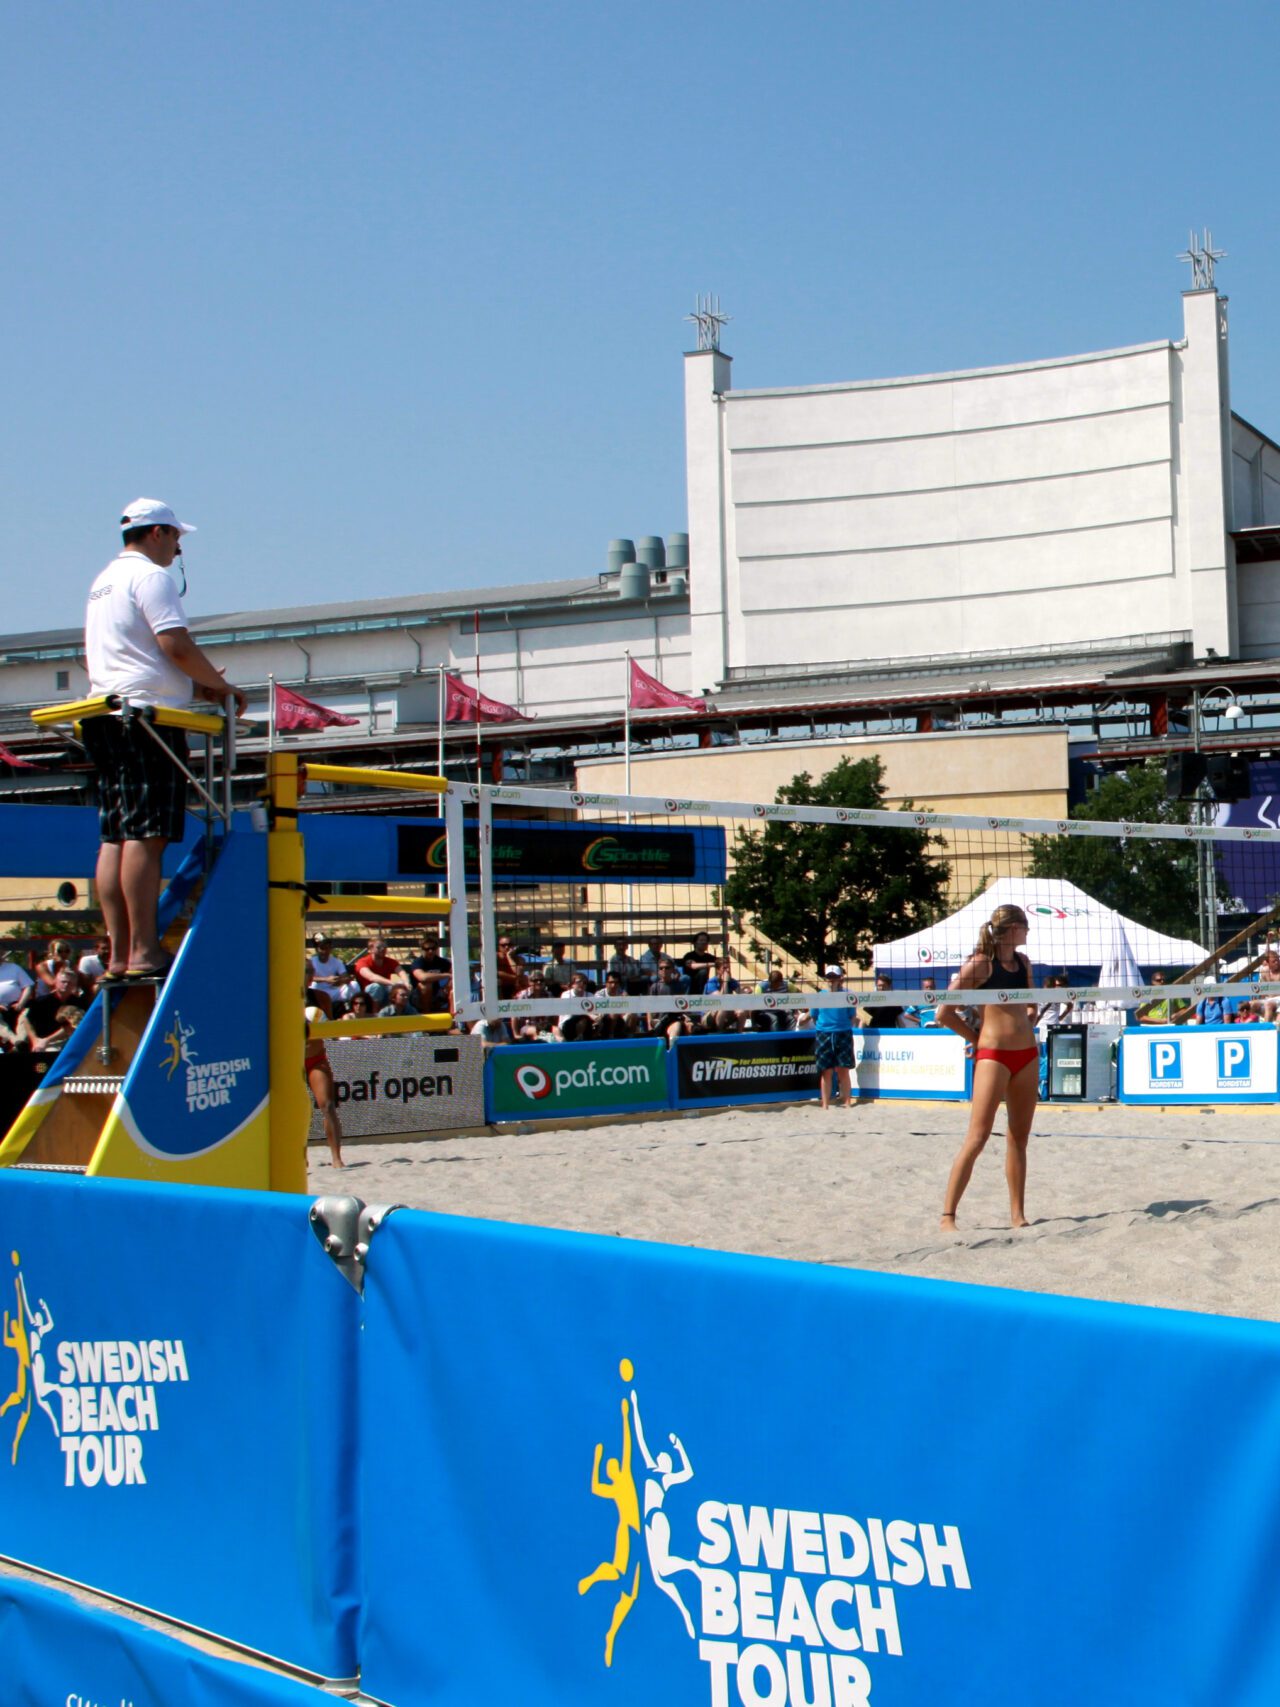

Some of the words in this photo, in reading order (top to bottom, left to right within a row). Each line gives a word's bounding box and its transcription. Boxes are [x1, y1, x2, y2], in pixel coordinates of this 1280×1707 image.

[584, 795, 620, 806] paf.com
[677, 801, 711, 812] paf.com
[765, 805, 797, 816] paf.com
[847, 811, 876, 821] paf.com
[595, 999, 630, 1010] paf.com
[689, 998, 721, 1008] paf.com
[776, 996, 807, 1006] paf.com
[186, 1057, 252, 1081] SWEDISH
[691, 1060, 818, 1083] GYMGROSSISTEN.com
[791, 1055, 817, 1063] Athlete
[857, 1050, 883, 1061] GAMLA
[885, 1050, 914, 1061] ULLEVI
[1156, 1043, 1176, 1078] P
[1224, 1042, 1244, 1077] P
[187, 1073, 237, 1096] BEACH
[334, 1070, 380, 1107] paf
[384, 1074, 453, 1104] open
[555, 1061, 650, 1096] paf.com
[186, 1089, 231, 1113] TOUR
[57, 1339, 189, 1384] SWEDISH
[61, 1384, 160, 1433] BEACH
[60, 1434, 147, 1487] TOUR
[696, 1500, 972, 1589] SWEDISH
[700, 1566, 904, 1656] BEACH
[698, 1639, 872, 1707] TOUR
